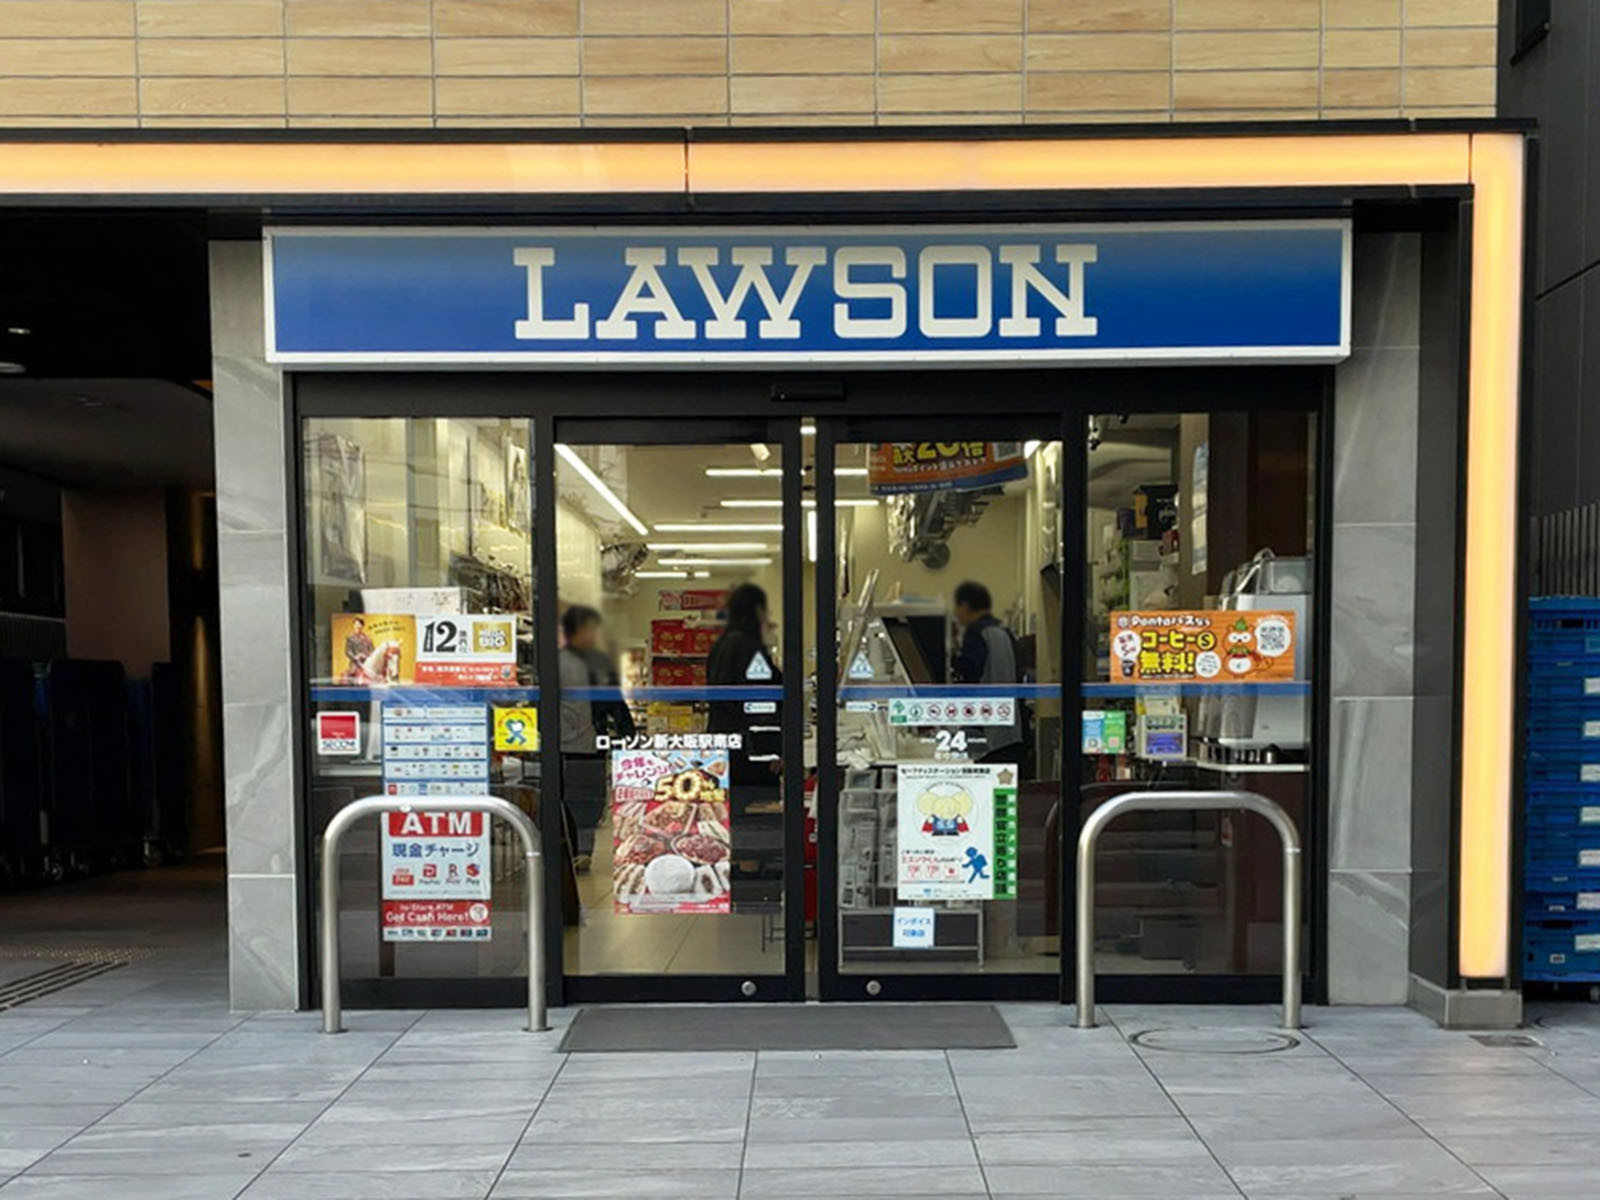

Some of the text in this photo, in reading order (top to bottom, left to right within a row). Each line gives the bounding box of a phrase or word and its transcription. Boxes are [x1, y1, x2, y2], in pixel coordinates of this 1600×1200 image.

[513, 244, 1098, 339] LAWSON
[423, 620, 457, 652] 12
[935, 730, 968, 752] 24
[400, 811, 472, 835] ATM
[391, 843, 480, 858] 現金チャージ
[386, 911, 469, 922] Get Cash Here!
